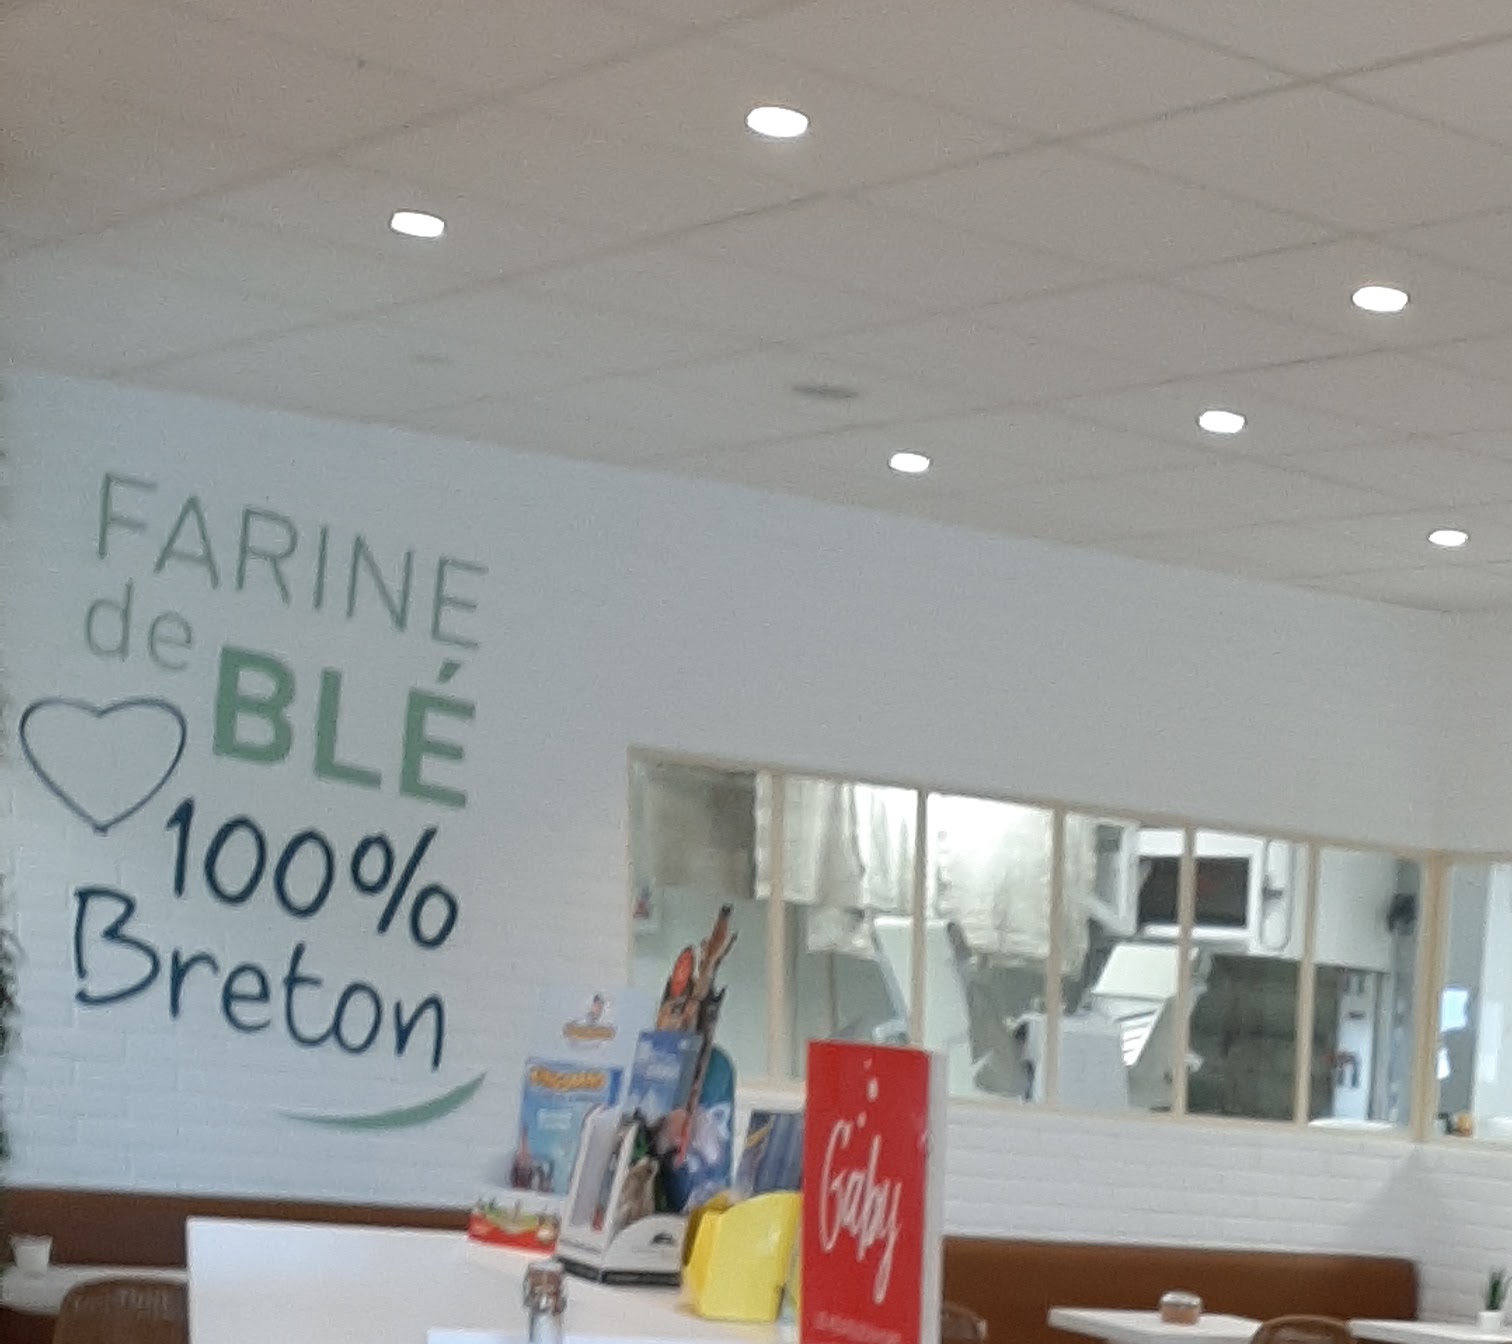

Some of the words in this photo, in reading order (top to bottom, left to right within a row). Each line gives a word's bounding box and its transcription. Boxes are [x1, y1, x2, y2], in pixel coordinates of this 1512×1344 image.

[85, 577, 193, 671] de
[99, 471, 488, 650] FARINE
[212, 644, 477, 808] BLÉ
[166, 797, 459, 949] 100%
[73, 886, 446, 1073] Breton
[818, 1119, 902, 1305] Gaby
